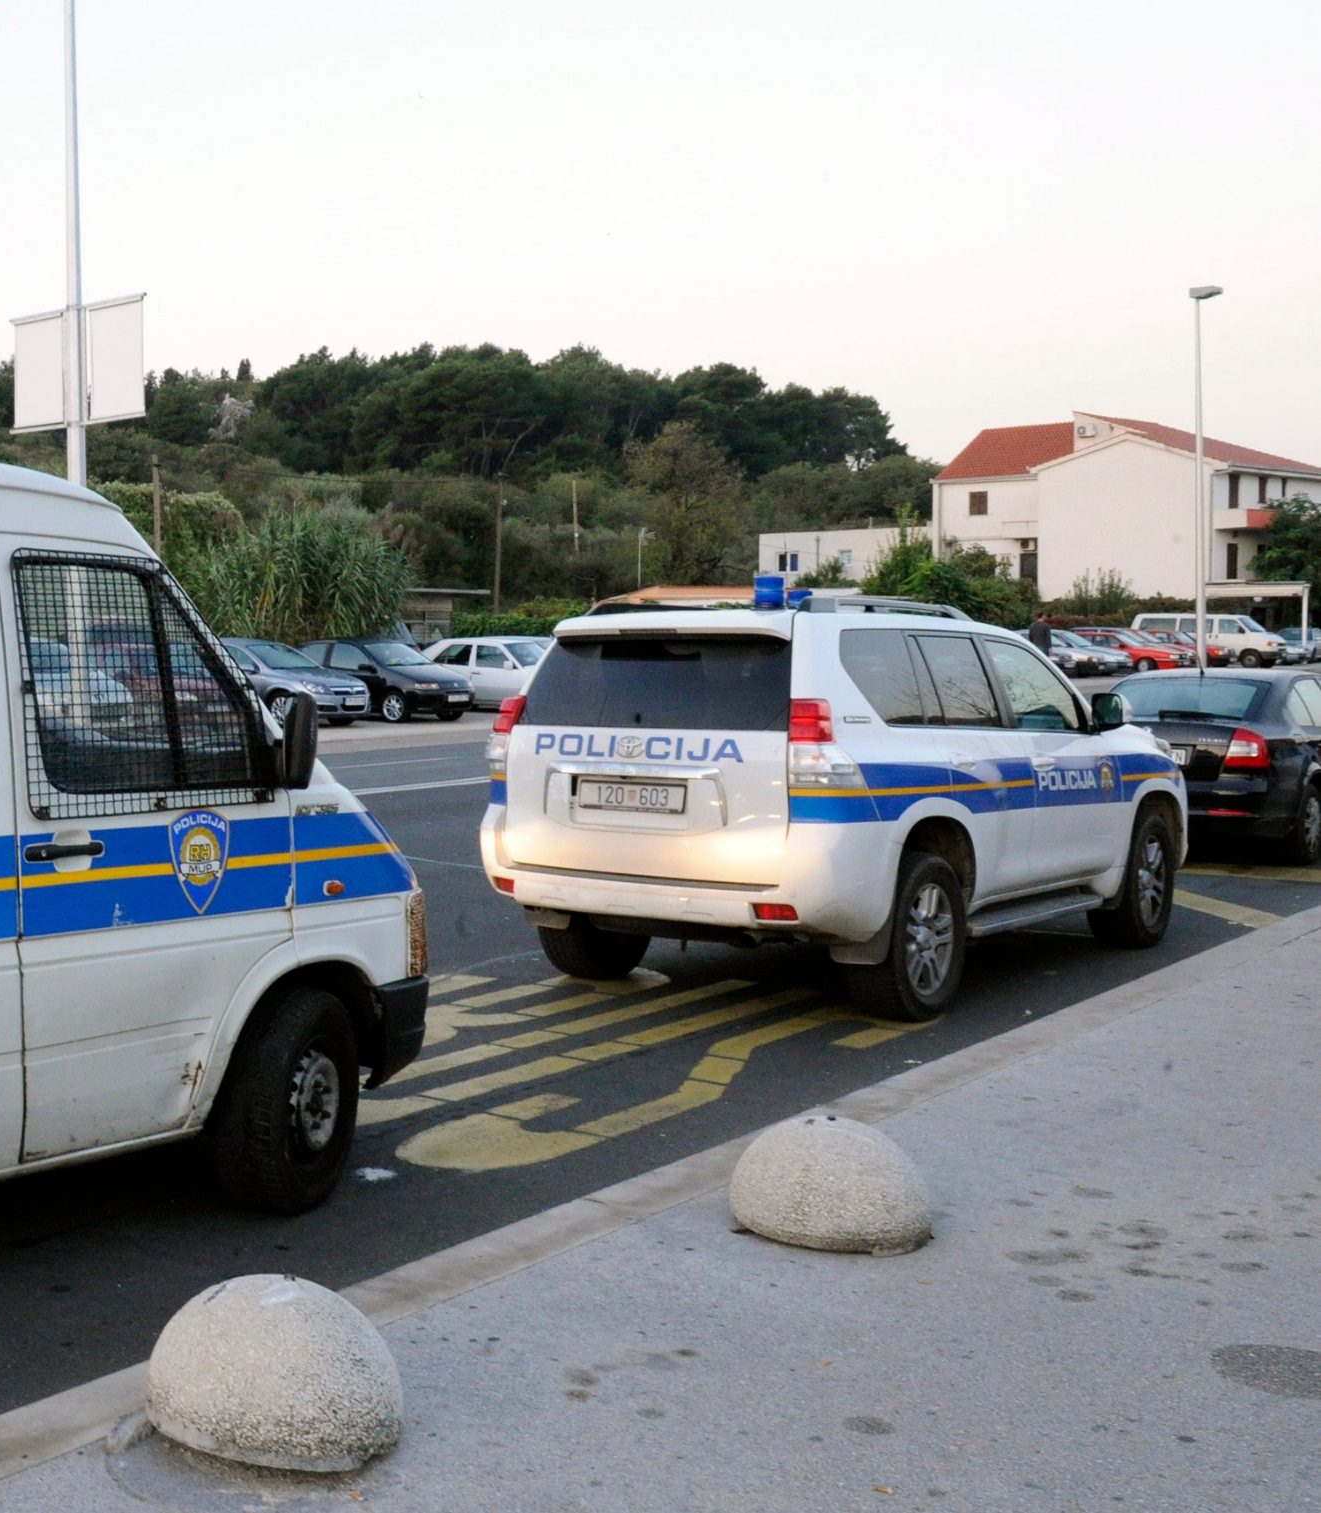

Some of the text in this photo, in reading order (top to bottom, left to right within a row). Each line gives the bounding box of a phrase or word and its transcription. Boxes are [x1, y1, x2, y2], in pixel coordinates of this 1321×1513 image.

[1038, 769, 1097, 791] POLICIJA
[598, 785, 669, 807] 120 603
[173, 814, 226, 835] POLICIJA
[189, 844, 211, 861] RH
[188, 863, 212, 873] MUP
